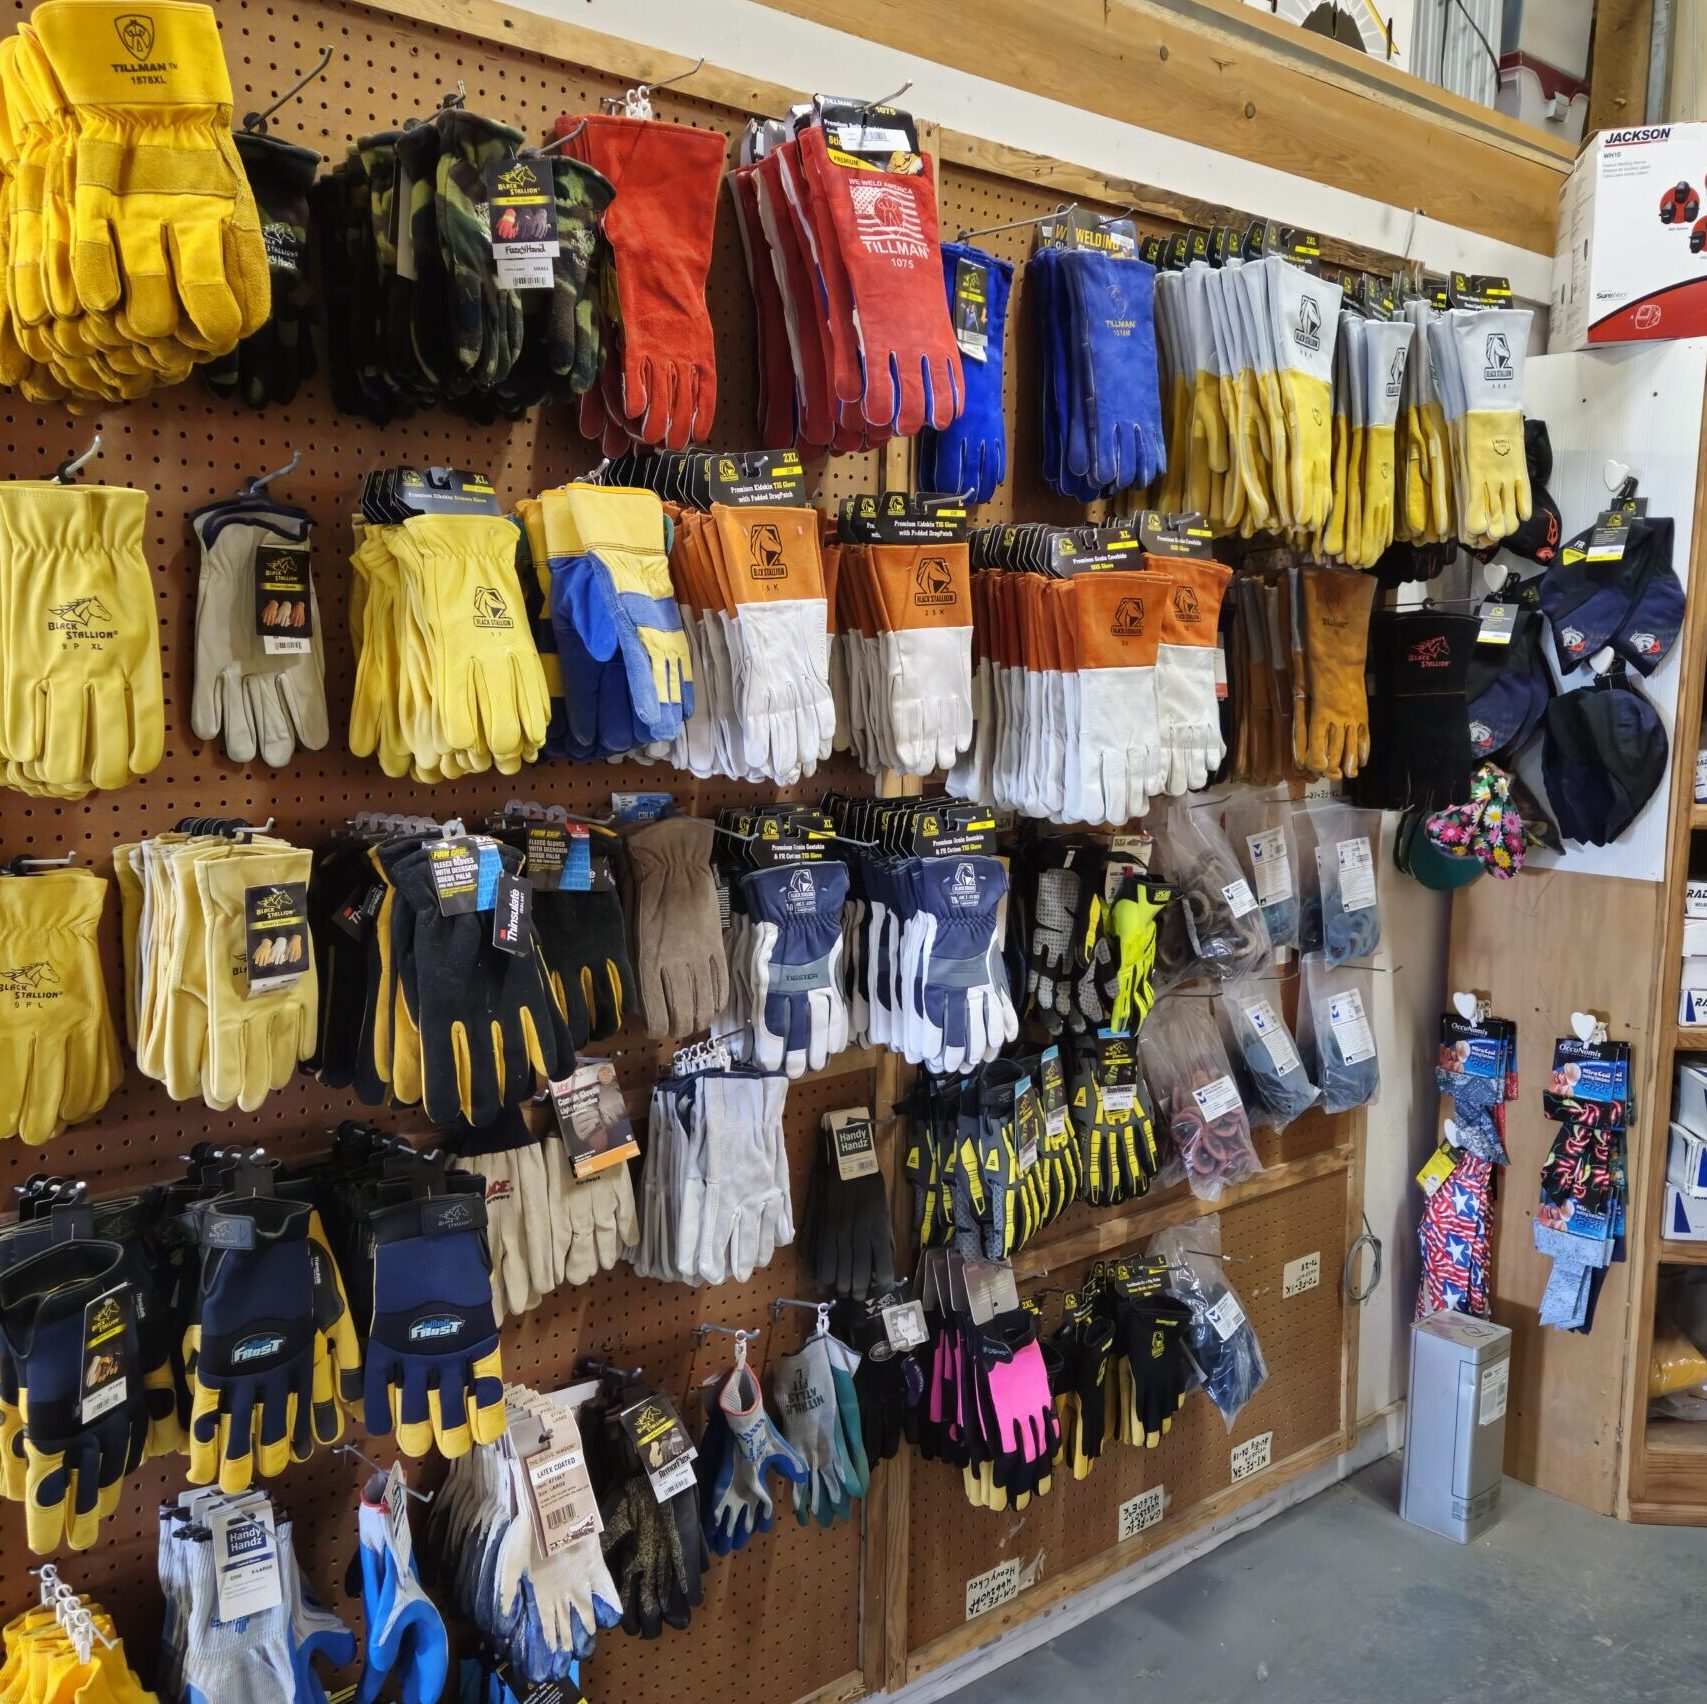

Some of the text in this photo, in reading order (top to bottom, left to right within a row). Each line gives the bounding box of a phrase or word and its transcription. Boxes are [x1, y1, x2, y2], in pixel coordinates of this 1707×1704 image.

[111, 62, 167, 73] TILLMAN
[875, 105, 897, 116] 1075
[1604, 127, 1672, 144] JACKSON
[834, 156, 859, 166] PREMIUM
[498, 183, 518, 192] BLACK
[510, 187, 539, 196] STALLION
[848, 178, 914, 195] WE WELD AMERICA
[863, 241, 930, 259] TILLMAN
[890, 258, 915, 269] 1075
[1105, 320, 1136, 329] TILLMAN
[783, 452, 799, 464] 2XL
[473, 474, 489, 484] XL
[730, 485, 753, 494] Premium
[1574, 540, 1586, 549] FR
[48, 622, 78, 631] BLACK
[66, 630, 118, 640] STALLION
[823, 819, 833, 828] XL
[433, 849, 449, 859] FIRM
[433, 860, 453, 869] FLEECE
[435, 864, 478, 876] WITH DEERSKIN
[437, 872, 472, 883] SUEDE PALM
[256, 907, 275, 916] BLACK
[267, 910, 293, 919] STALLION
[506, 888, 520, 942] Thinsulate
[15, 992, 58, 1000] STALLION
[840, 1129, 867, 1142] Handy
[841, 1139, 869, 1152] Handz
[575, 1175, 601, 1186] Hardware
[537, 1457, 576, 1479] LATEX COATED
[658, 1453, 691, 1479] ArmorFlex
[230, 1526, 262, 1543] Handy
[231, 1536, 263, 1552] Handz
[968, 1566, 1015, 1591] Heavy Chev
